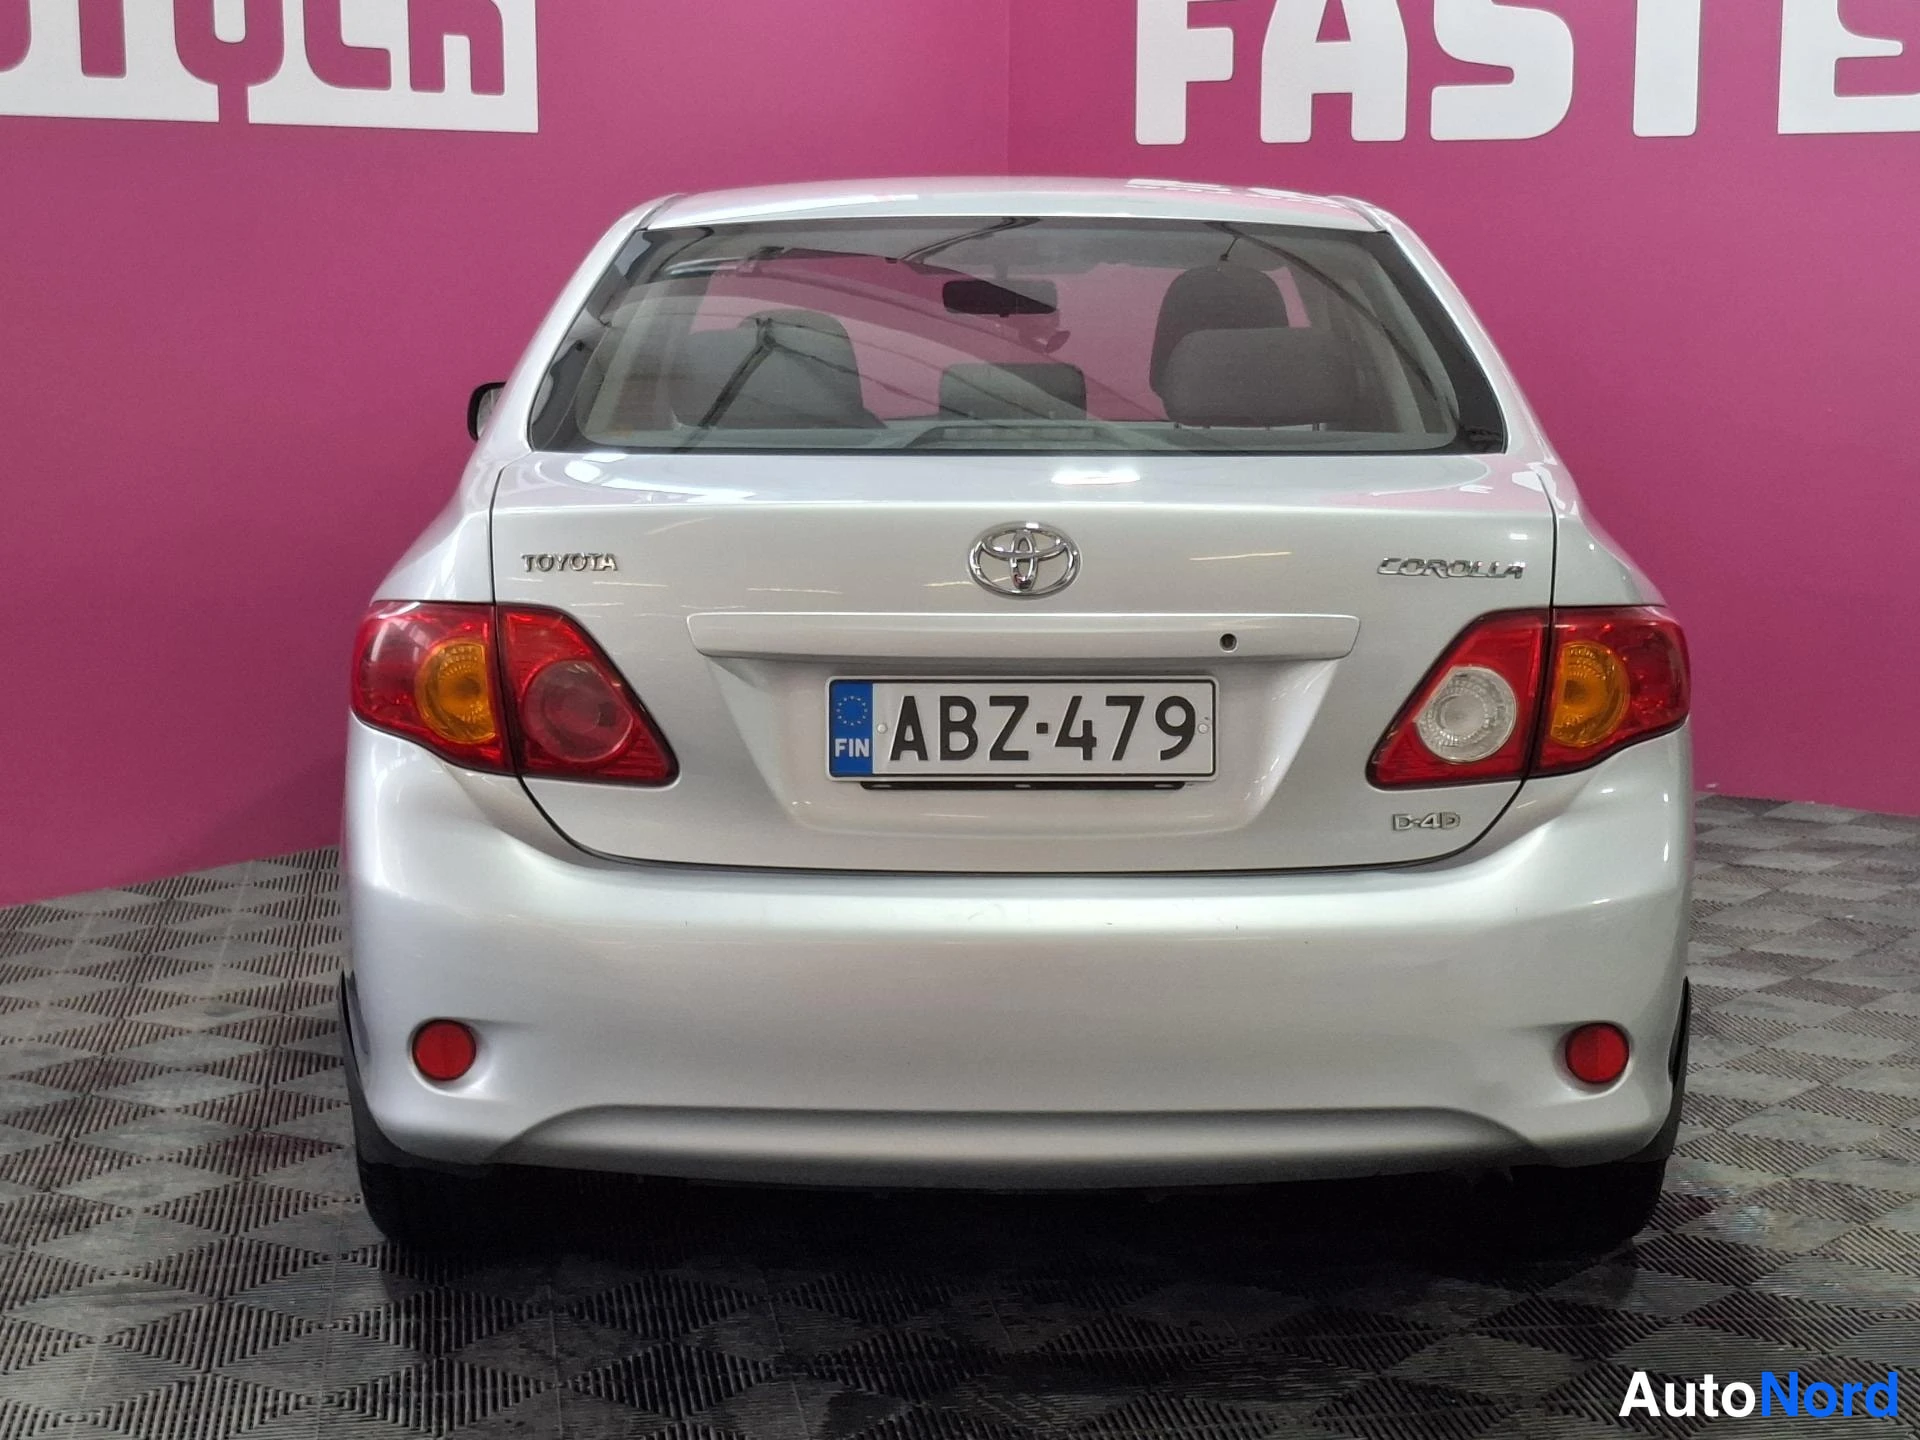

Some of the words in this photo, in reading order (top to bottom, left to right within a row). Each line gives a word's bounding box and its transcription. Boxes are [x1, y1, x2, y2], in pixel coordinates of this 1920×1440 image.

[521, 553, 618, 572] TOYOTA
[1377, 558, 1526, 579] COROLLA
[834, 738, 870, 758] FIN
[1392, 811, 1462, 832] D-4D
